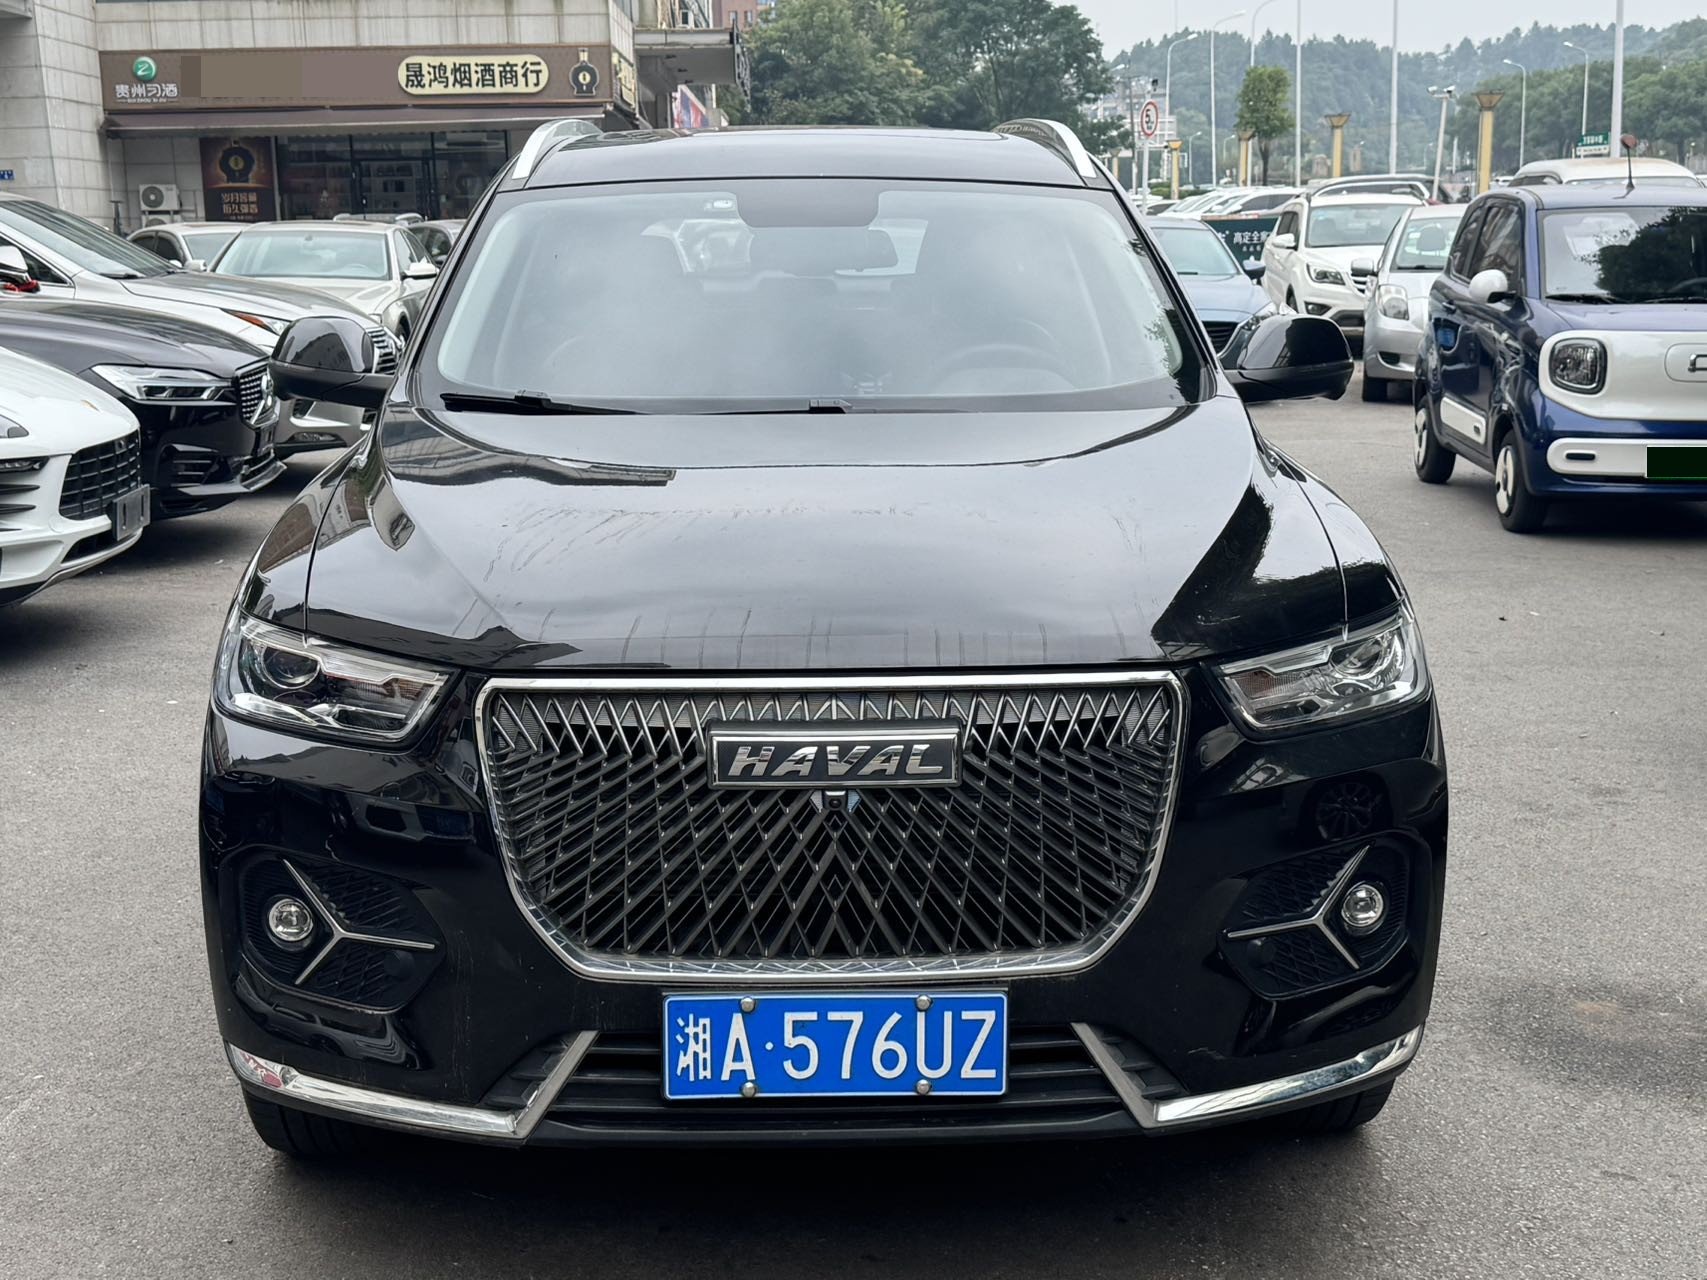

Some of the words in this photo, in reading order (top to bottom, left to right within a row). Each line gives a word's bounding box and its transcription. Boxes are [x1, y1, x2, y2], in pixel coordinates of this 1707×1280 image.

[405, 61, 542, 89] 晟鸿烟酒商行
[115, 83, 178, 98] 贵州习酒
[728, 744, 944, 777] HAVAL
